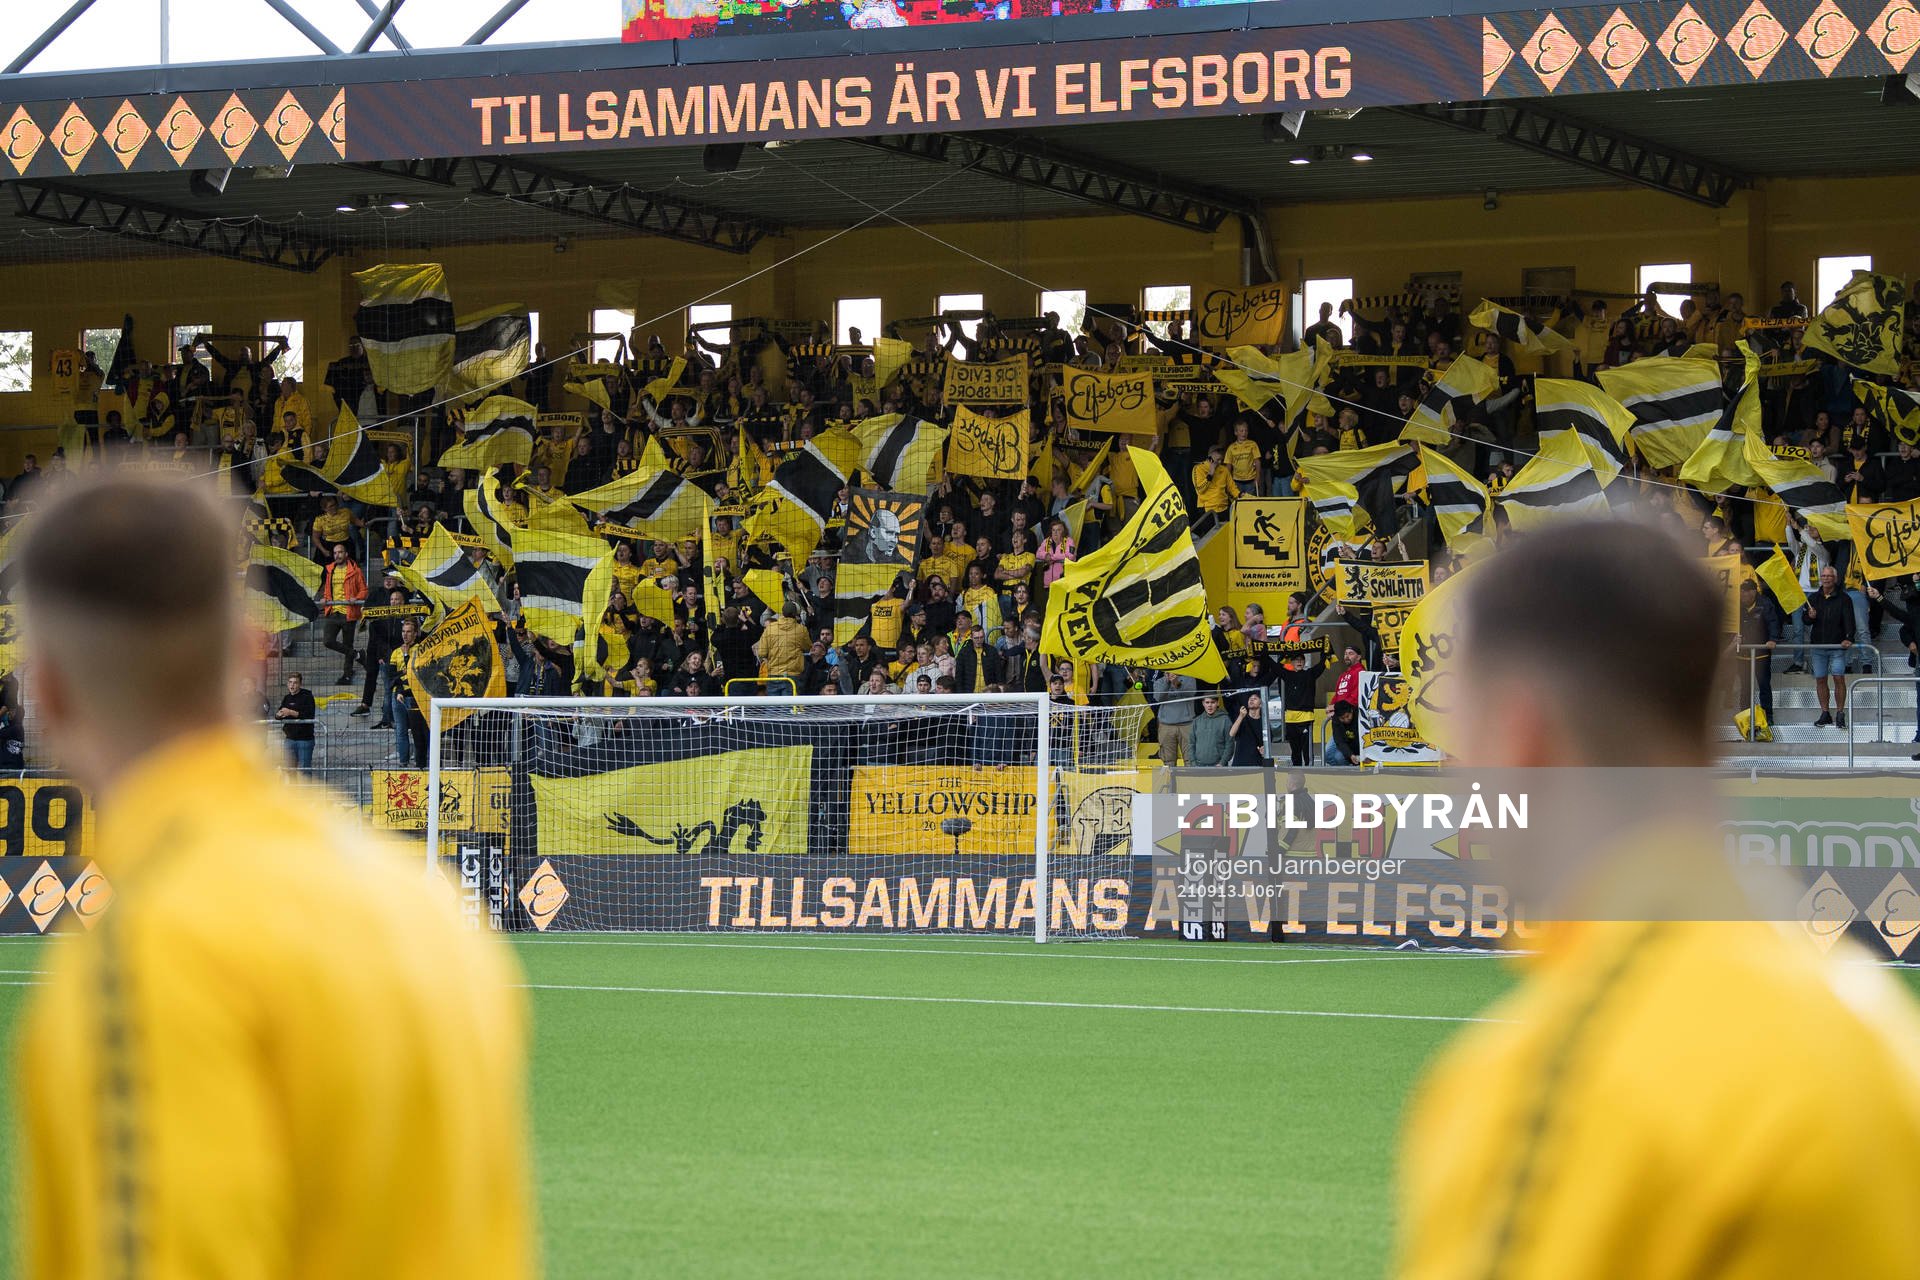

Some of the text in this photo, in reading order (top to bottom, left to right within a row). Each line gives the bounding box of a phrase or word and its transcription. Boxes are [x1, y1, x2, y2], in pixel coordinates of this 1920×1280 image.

[472, 46, 1352, 145] TILLSAMMANS ÄR VI ELFSBORG
[1200, 289, 1282, 341] Elfsborg
[56, 359, 72, 377] 43
[1066, 374, 1148, 424] Elfsborg
[1865, 503, 1920, 567] Elfsb
[1277, 571, 1292, 579] FÖR
[1370, 574, 1425, 599] SCHLÄTTA
[1253, 639, 1323, 652] IF ELFSBORG
[938, 777, 962, 788] THE
[865, 791, 1037, 816] YELLOWSHIP
[489, 846, 502, 932] SELECT
[700, 877, 1129, 931] TILLSAMMANS
